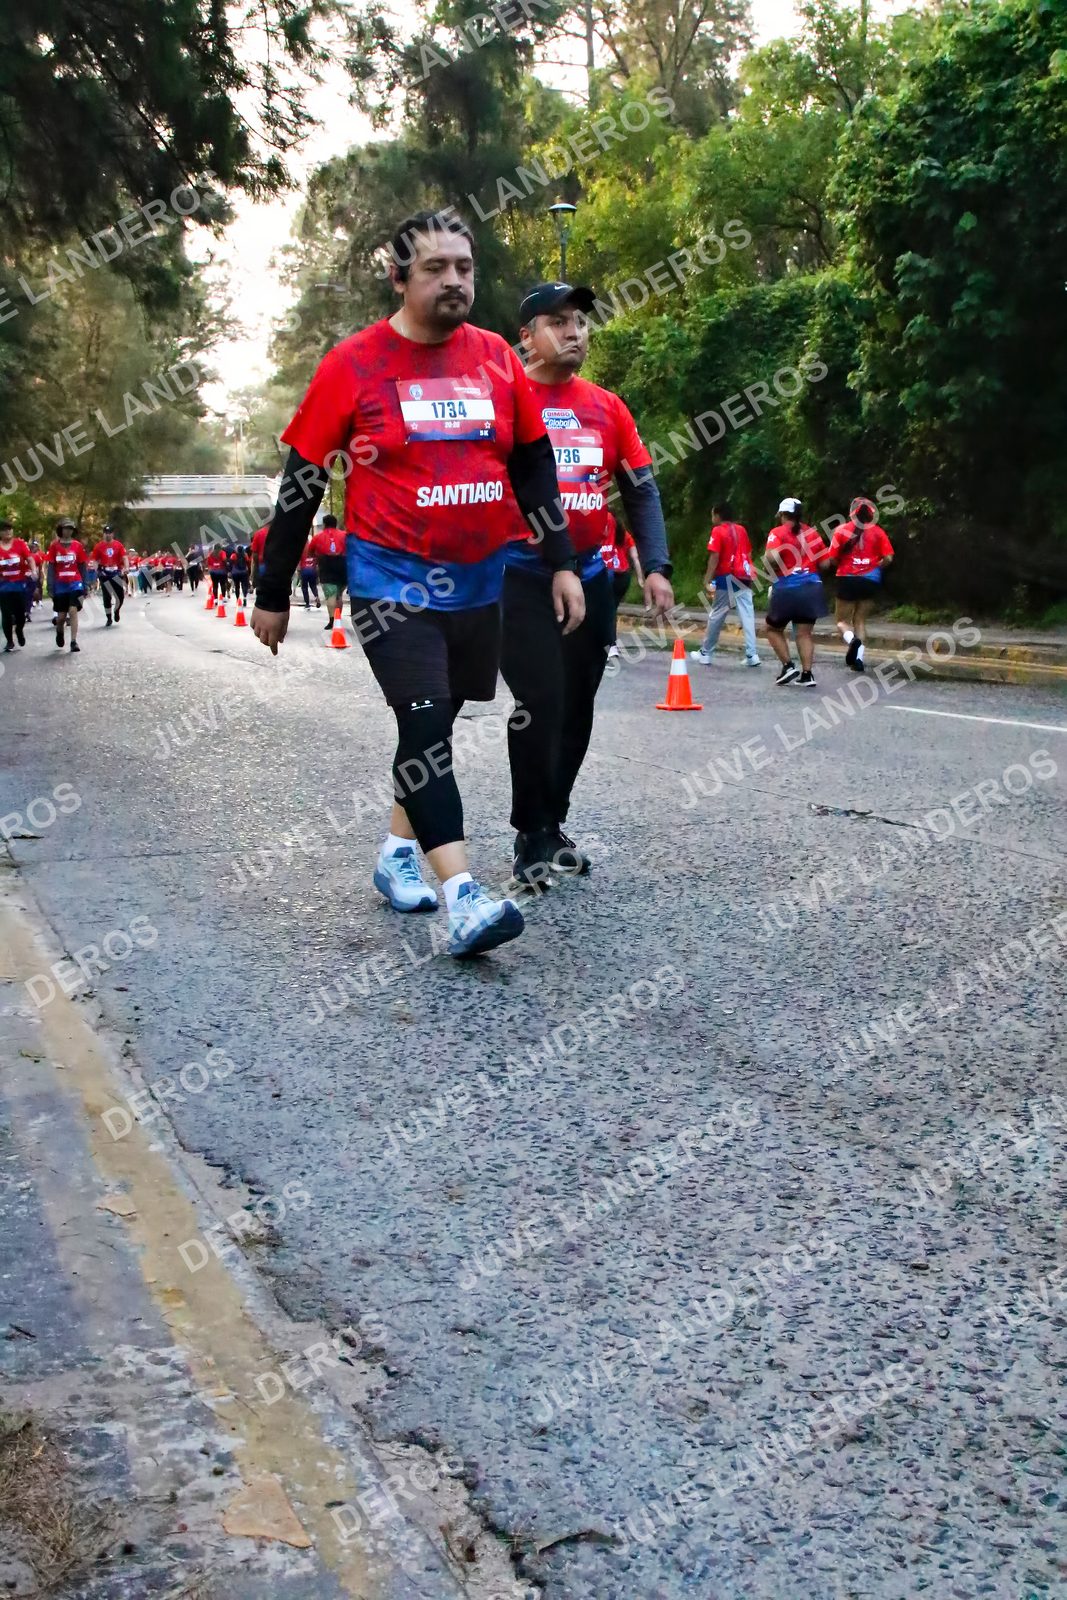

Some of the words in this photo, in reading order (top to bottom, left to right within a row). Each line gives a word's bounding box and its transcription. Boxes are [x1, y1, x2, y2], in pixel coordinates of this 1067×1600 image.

[431, 400, 467, 418] 1734
[555, 448, 580, 464] 736
[416, 480, 503, 507] SANTIAGO
